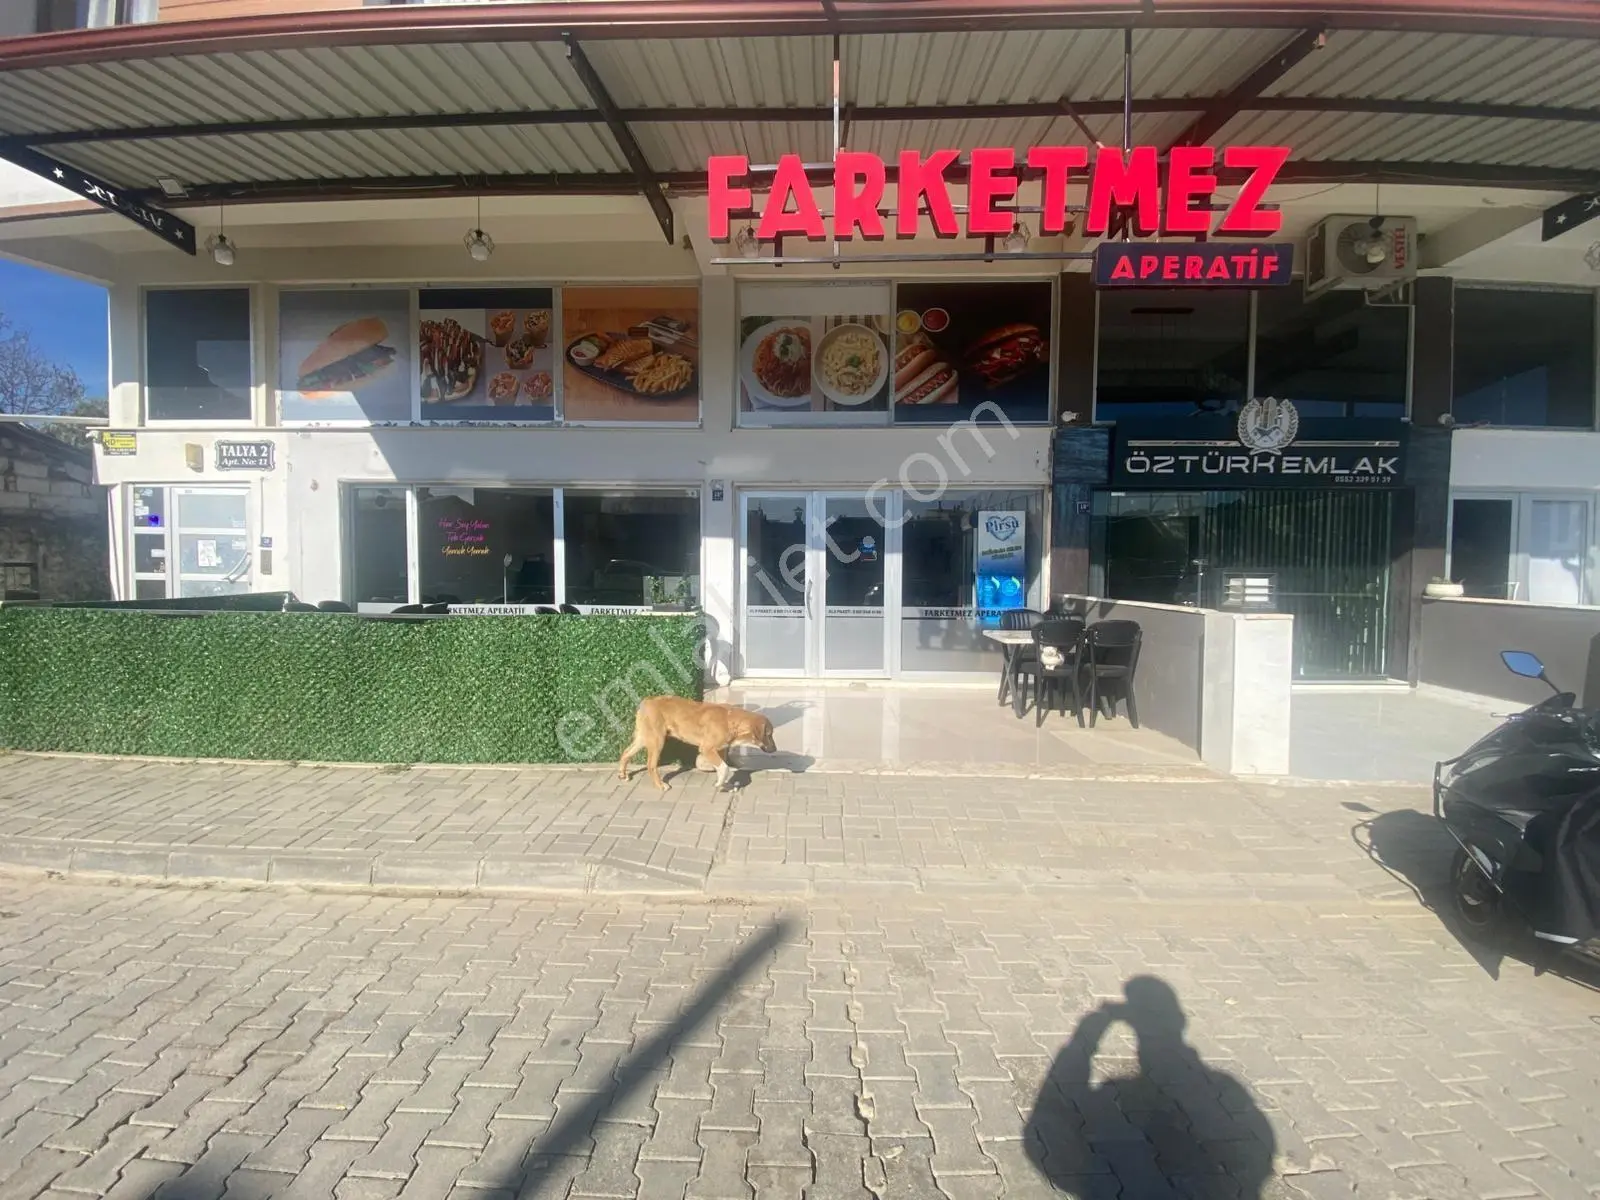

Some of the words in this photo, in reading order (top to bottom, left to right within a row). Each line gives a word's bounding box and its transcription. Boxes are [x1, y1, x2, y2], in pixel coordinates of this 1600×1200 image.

[708, 146, 1291, 240] FARKETMEZ
[1110, 248, 1280, 280] APERATİF
[220, 445, 257, 457] TALYA
[260, 445, 268, 457] 2
[221, 458, 240, 466] Apt.
[1126, 451, 1275, 474] ÖZTÜRK
[1281, 456, 1398, 474] EMLAK
